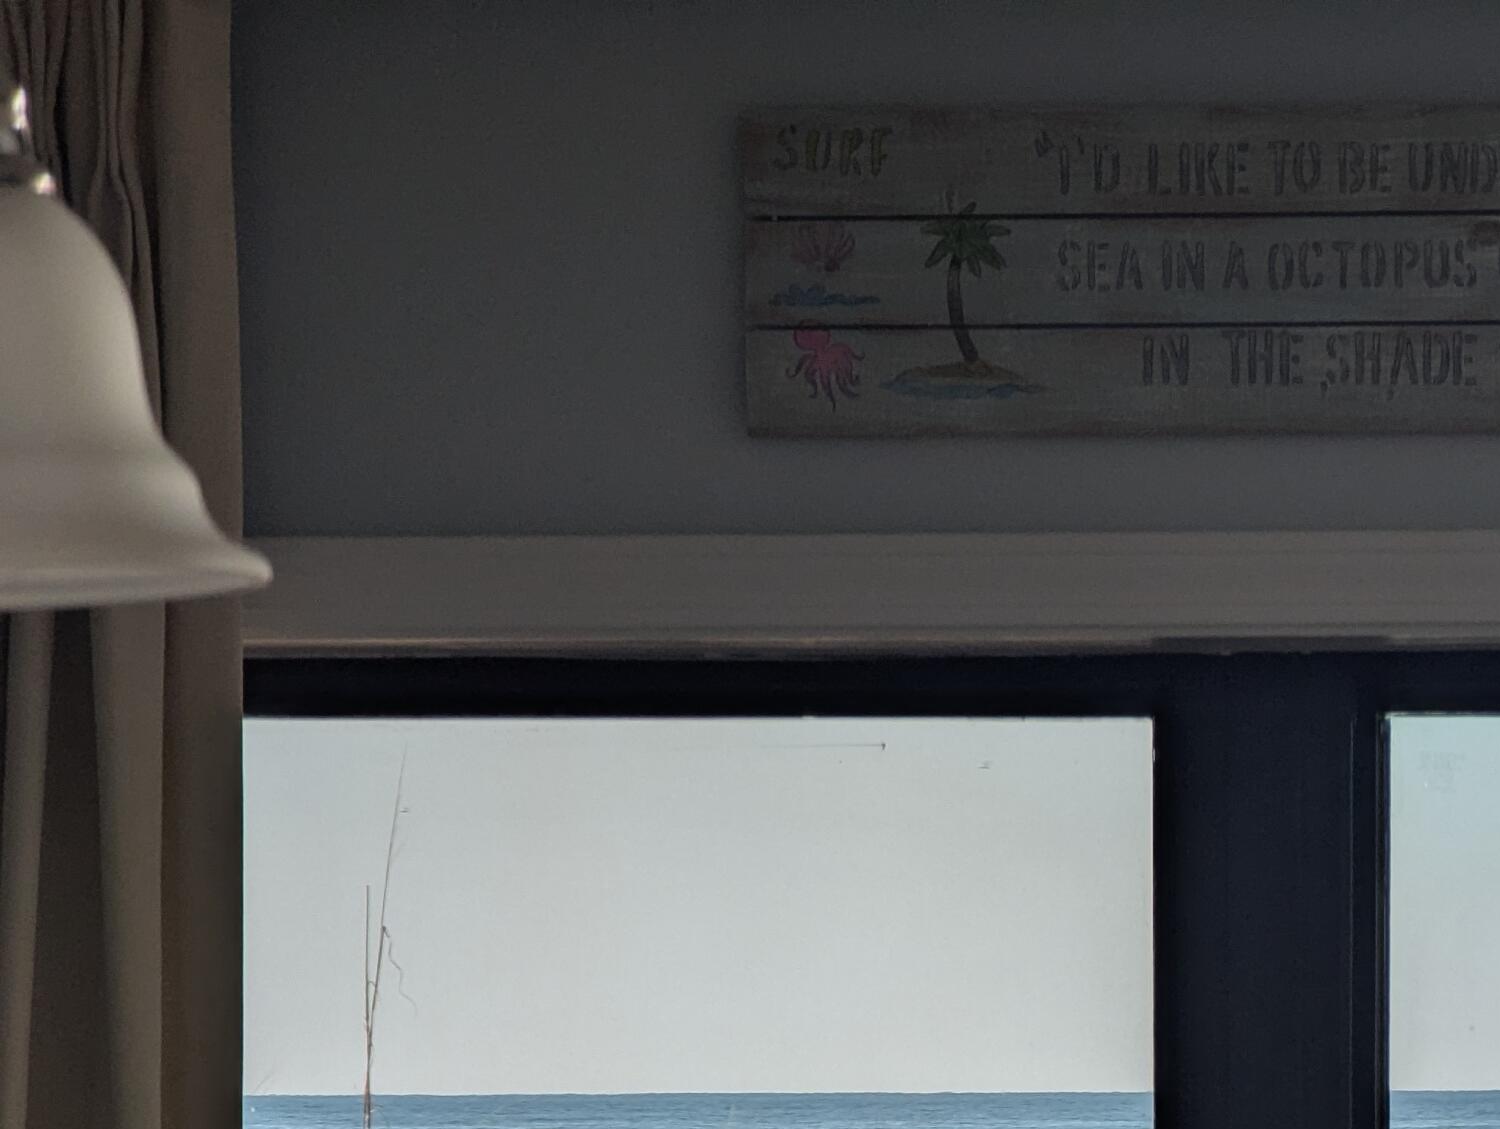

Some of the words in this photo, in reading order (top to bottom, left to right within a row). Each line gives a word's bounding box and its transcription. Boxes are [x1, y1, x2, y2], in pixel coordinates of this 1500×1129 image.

[773, 124, 892, 177] SURF
[1147, 142, 1250, 195] LIKE
[1267, 140, 1322, 195] TO
[1337, 142, 1392, 194] BE
[1057, 240, 1144, 291] SEA
[1161, 240, 1205, 291] IN
[1222, 241, 1249, 289] A
[1267, 239, 1478, 290] OCTOPUS
[1142, 334, 1190, 386] IN
[1222, 330, 1304, 386] THE
